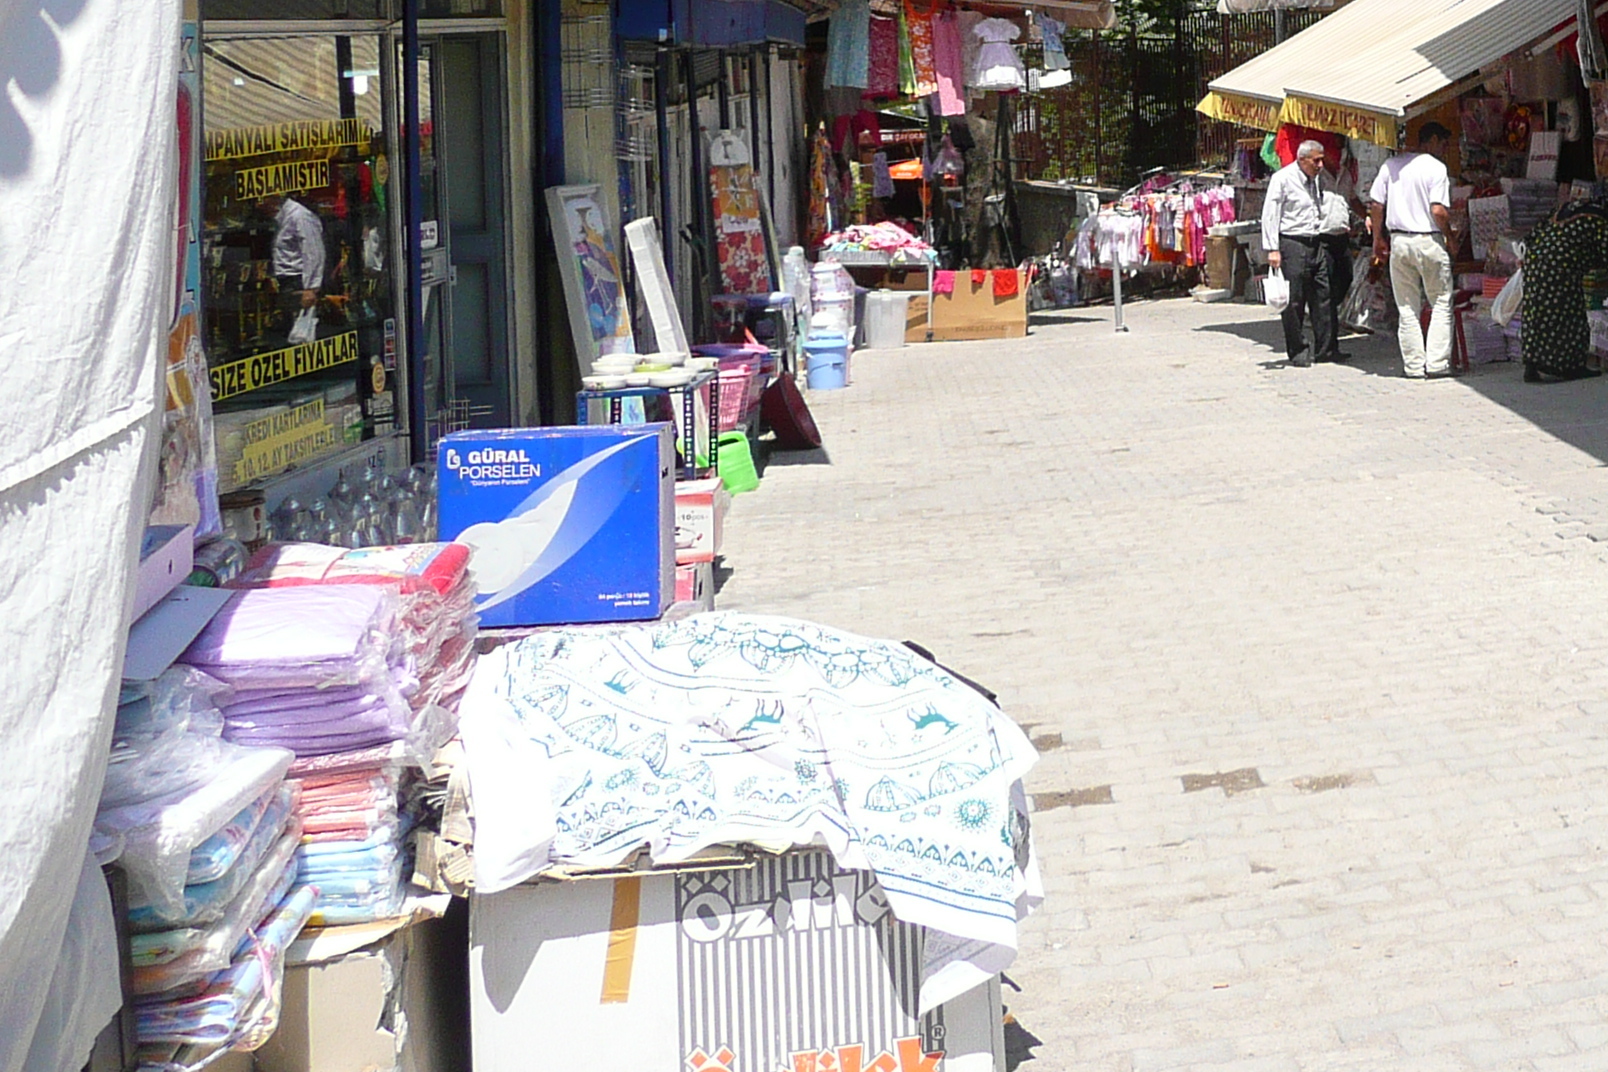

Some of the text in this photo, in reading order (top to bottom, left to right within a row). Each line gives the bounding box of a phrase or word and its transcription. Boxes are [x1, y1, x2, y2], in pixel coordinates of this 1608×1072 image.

[204, 125, 277, 158] MPANYALI
[467, 447, 530, 465] GÜRAL
[459, 463, 541, 480] PORSELEN
[681, 872, 891, 943] Özdile
